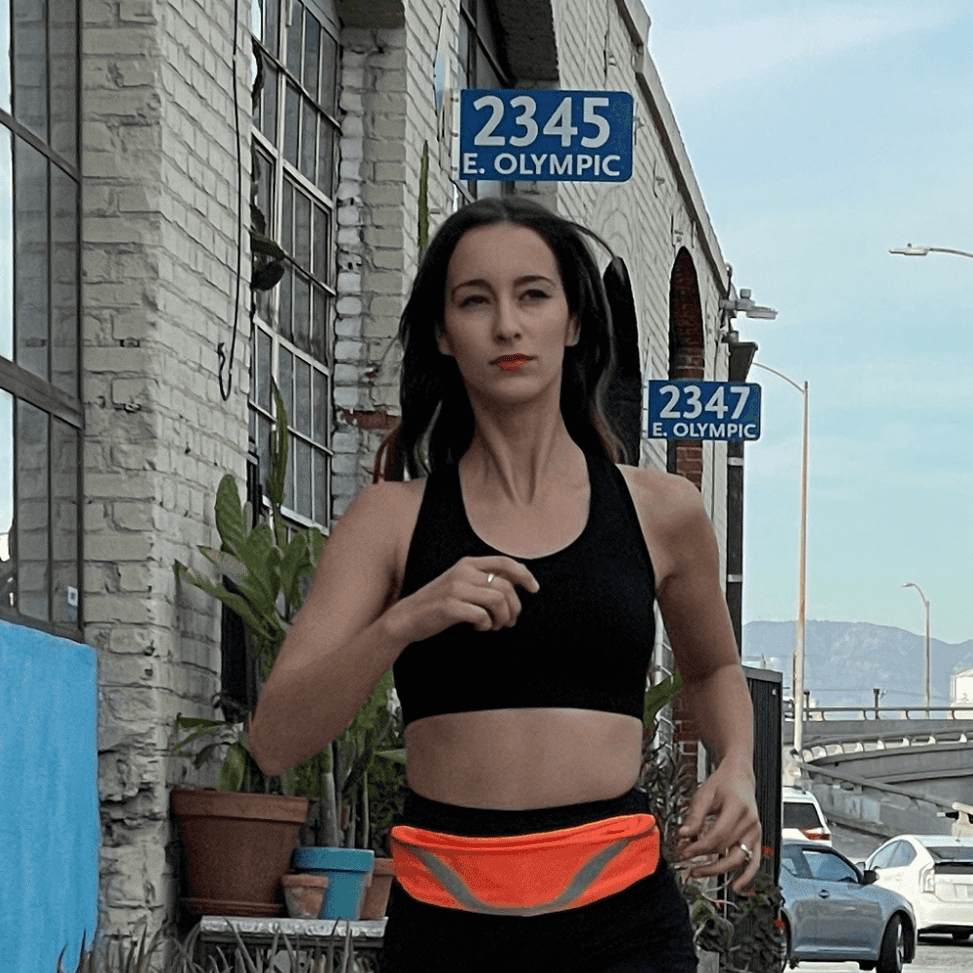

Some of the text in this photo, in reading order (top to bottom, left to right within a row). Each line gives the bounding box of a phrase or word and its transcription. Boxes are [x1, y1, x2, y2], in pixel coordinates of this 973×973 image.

[472, 95, 611, 149] 2345
[462, 152, 622, 177] E. OLYMPIC
[659, 384, 751, 420] 2347
[652, 421, 757, 439] E. OLYMPIC
